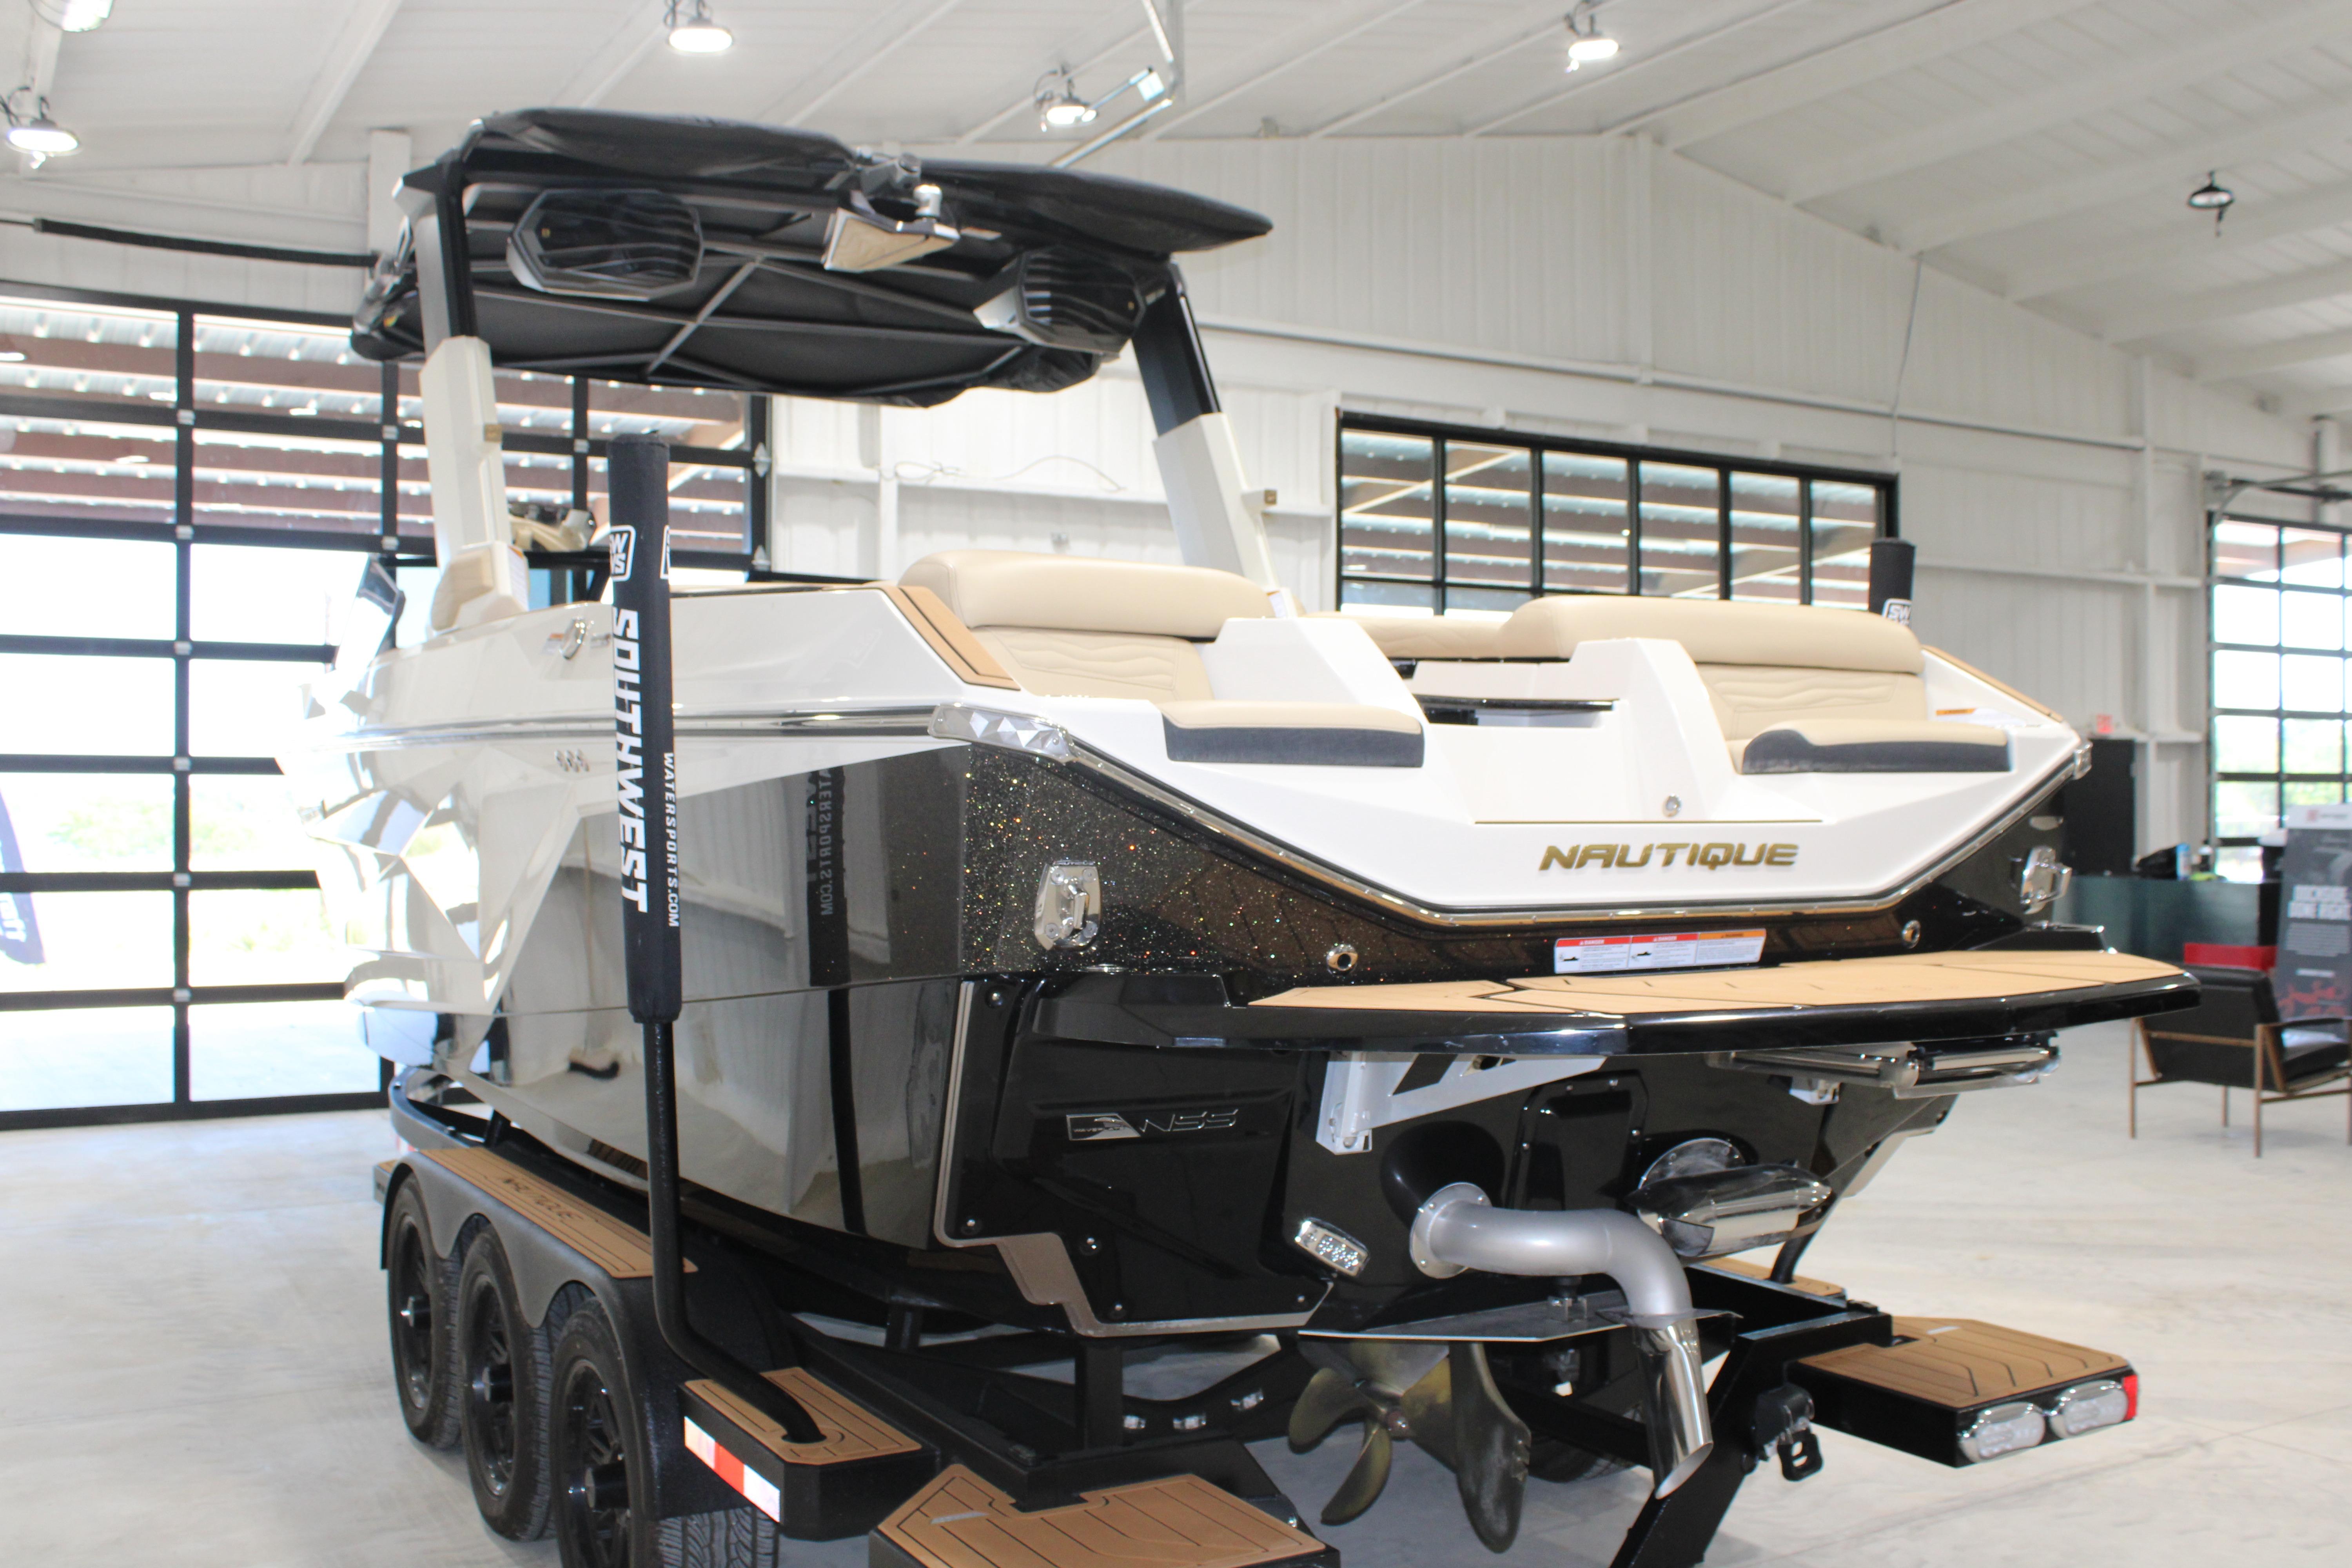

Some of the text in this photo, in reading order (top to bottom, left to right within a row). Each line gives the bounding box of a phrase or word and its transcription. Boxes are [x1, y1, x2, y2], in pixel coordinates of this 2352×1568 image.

[613, 608, 648, 913] SOUTHWEST
[664, 752, 680, 927] WATERSPORTS.COM
[1539, 843, 1798, 870] NAUTIQUE
[1140, 1109, 1238, 1132] NSS
